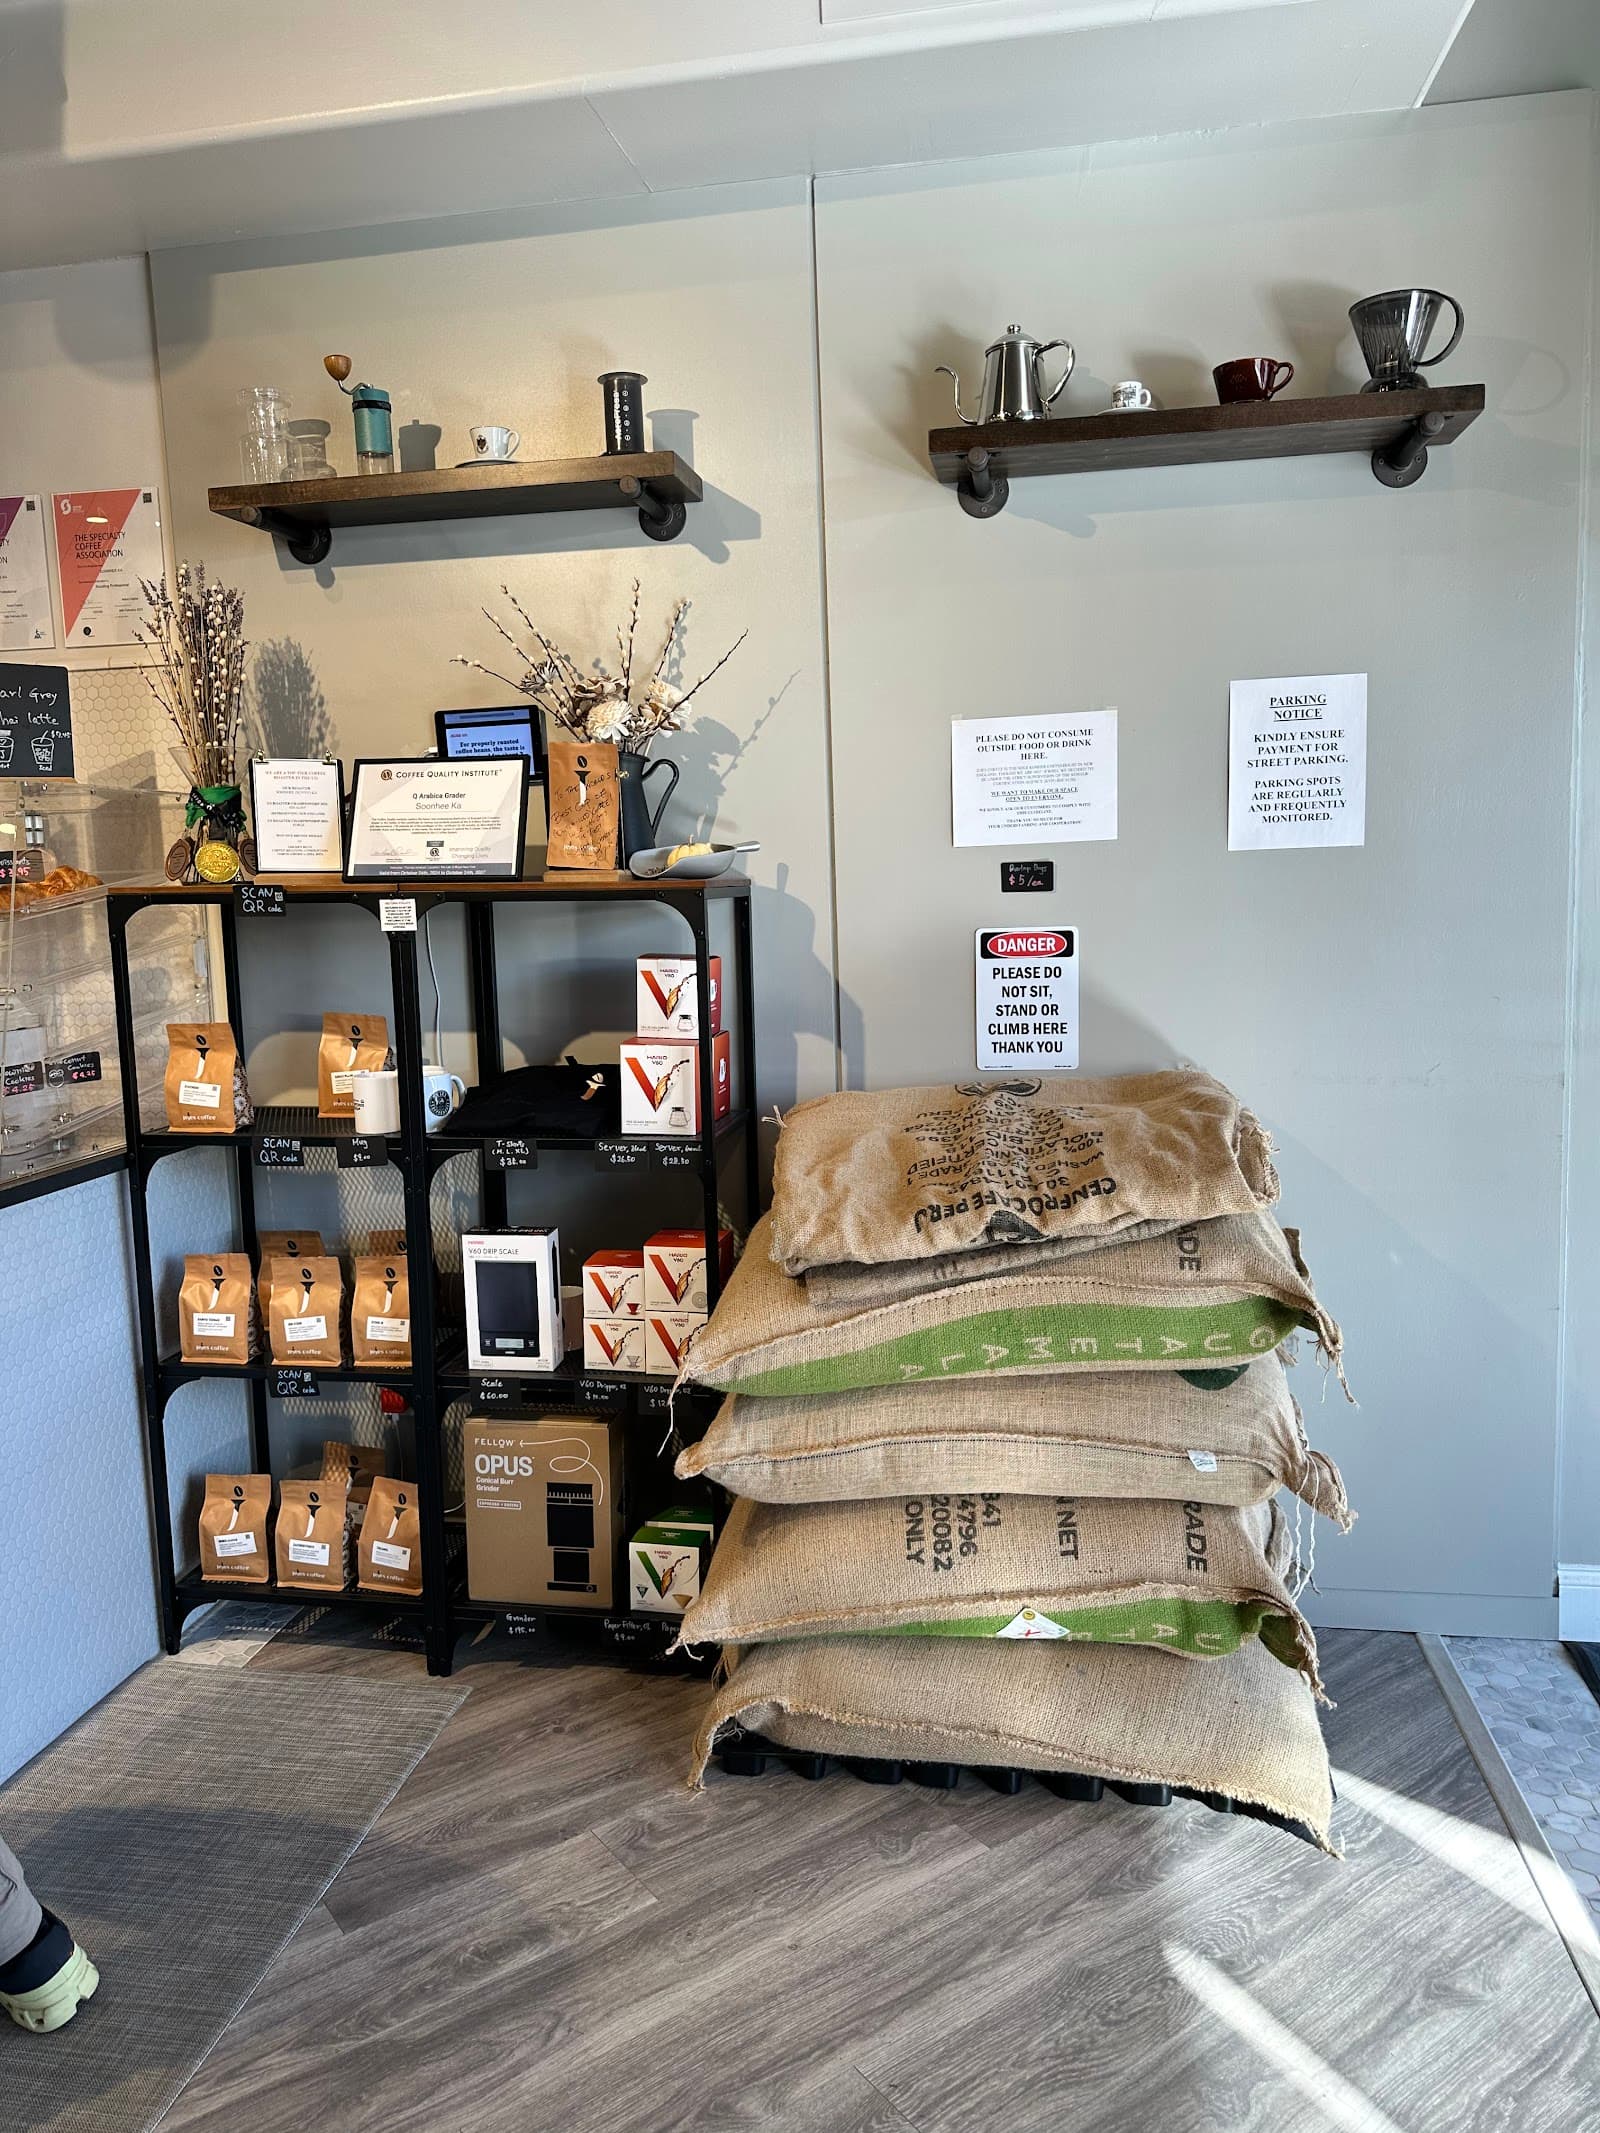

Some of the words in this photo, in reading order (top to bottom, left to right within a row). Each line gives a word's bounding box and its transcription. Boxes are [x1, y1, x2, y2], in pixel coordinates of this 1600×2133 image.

[75, 534, 88, 542] THE
[89, 531, 126, 541] SPECIALTY
[75, 542, 102, 550] COFFEE
[76, 549, 124, 559] ASSOCIATION
[0, 686, 21, 698] arl
[29, 687, 57, 706] Grey
[1269, 693, 1327, 707] PARKING
[27, 712, 59, 725] latte
[1273, 708, 1323, 721] NOTICE
[976, 733, 1011, 743] PLEASE
[1011, 733, 1026, 741] DO
[1027, 731, 1047, 740] NOT
[1048, 728, 1094, 739] CONSUME
[1254, 731, 1298, 743] KINDLY
[1300, 729, 1345, 740] ENSURE
[977, 743, 1018, 753] OUTSIDE
[1019, 741, 1045, 751] FOOD
[1046, 740, 1060, 749] OR
[1062, 738, 1092, 747] DRINK
[1258, 743, 1312, 755] PAYMENT
[1315, 742, 1339, 752] FOR
[1020, 751, 1049, 760] HERE.
[1247, 757, 1292, 768] STREET
[1294, 754, 1349, 766] PARKING.
[396, 770, 425, 779] COFFEE
[427, 770, 459, 778] QUALITY
[461, 769, 499, 777] INSTITUTE
[1255, 777, 1304, 789] PARKING
[1306, 775, 1341, 786] SPOTS
[412, 792, 418, 800] Q
[419, 792, 443, 800] Arabica
[444, 791, 466, 799] Grader
[1252, 791, 1274, 801] ARE
[1276, 787, 1344, 799] REGULARLY
[1248, 803, 1272, 813] AND
[1274, 799, 1347, 812] FREQUENTLY
[1262, 812, 1333, 823] MONITORED.
[241, 887, 274, 899] SCAN
[242, 899, 266, 913] QR
[997, 938, 1056, 953] DANGER
[992, 966, 1041, 979] PLEASE
[1044, 966, 1062, 978] DO
[1001, 985, 1027, 998] NOT
[1029, 985, 1053, 999] SIT,
[995, 1004, 1037, 1017] STAND
[1041, 1003, 1059, 1016] OR
[988, 1023, 1030, 1035] CLIMB
[1033, 1022, 1068, 1035] HERE
[992, 1041, 1034, 1053] THANK
[1037, 1040, 1063, 1053] YOU
[263, 1138, 291, 1148] SCAN
[352, 1138, 368, 1150] Mug
[260, 1150, 280, 1163] QR
[282, 1153, 298, 1162] code
[1034, 1150, 1105, 1172] WASHED
[900, 1325, 1277, 1379] GUATEMALA
[278, 1370, 302, 1379] SCAN
[277, 1380, 299, 1394] QR
[480, 1378, 504, 1388] Scale
[580, 1380, 595, 1388] V60
[475, 1438, 514, 1448] FELLOW
[475, 1454, 534, 1477] OPUS
[476, 1476, 499, 1485] Conical
[500, 1478, 514, 1486] Burr
[476, 1484, 500, 1492] Grinder
[957, 1493, 978, 1557] 4796
[905, 1501, 925, 1565] ONLY
[1057, 1510, 1079, 1560] NET
[1183, 1501, 1208, 1573] RADE
[506, 1613, 537, 1623] Grinder
[604, 1618, 622, 1631] Paper
